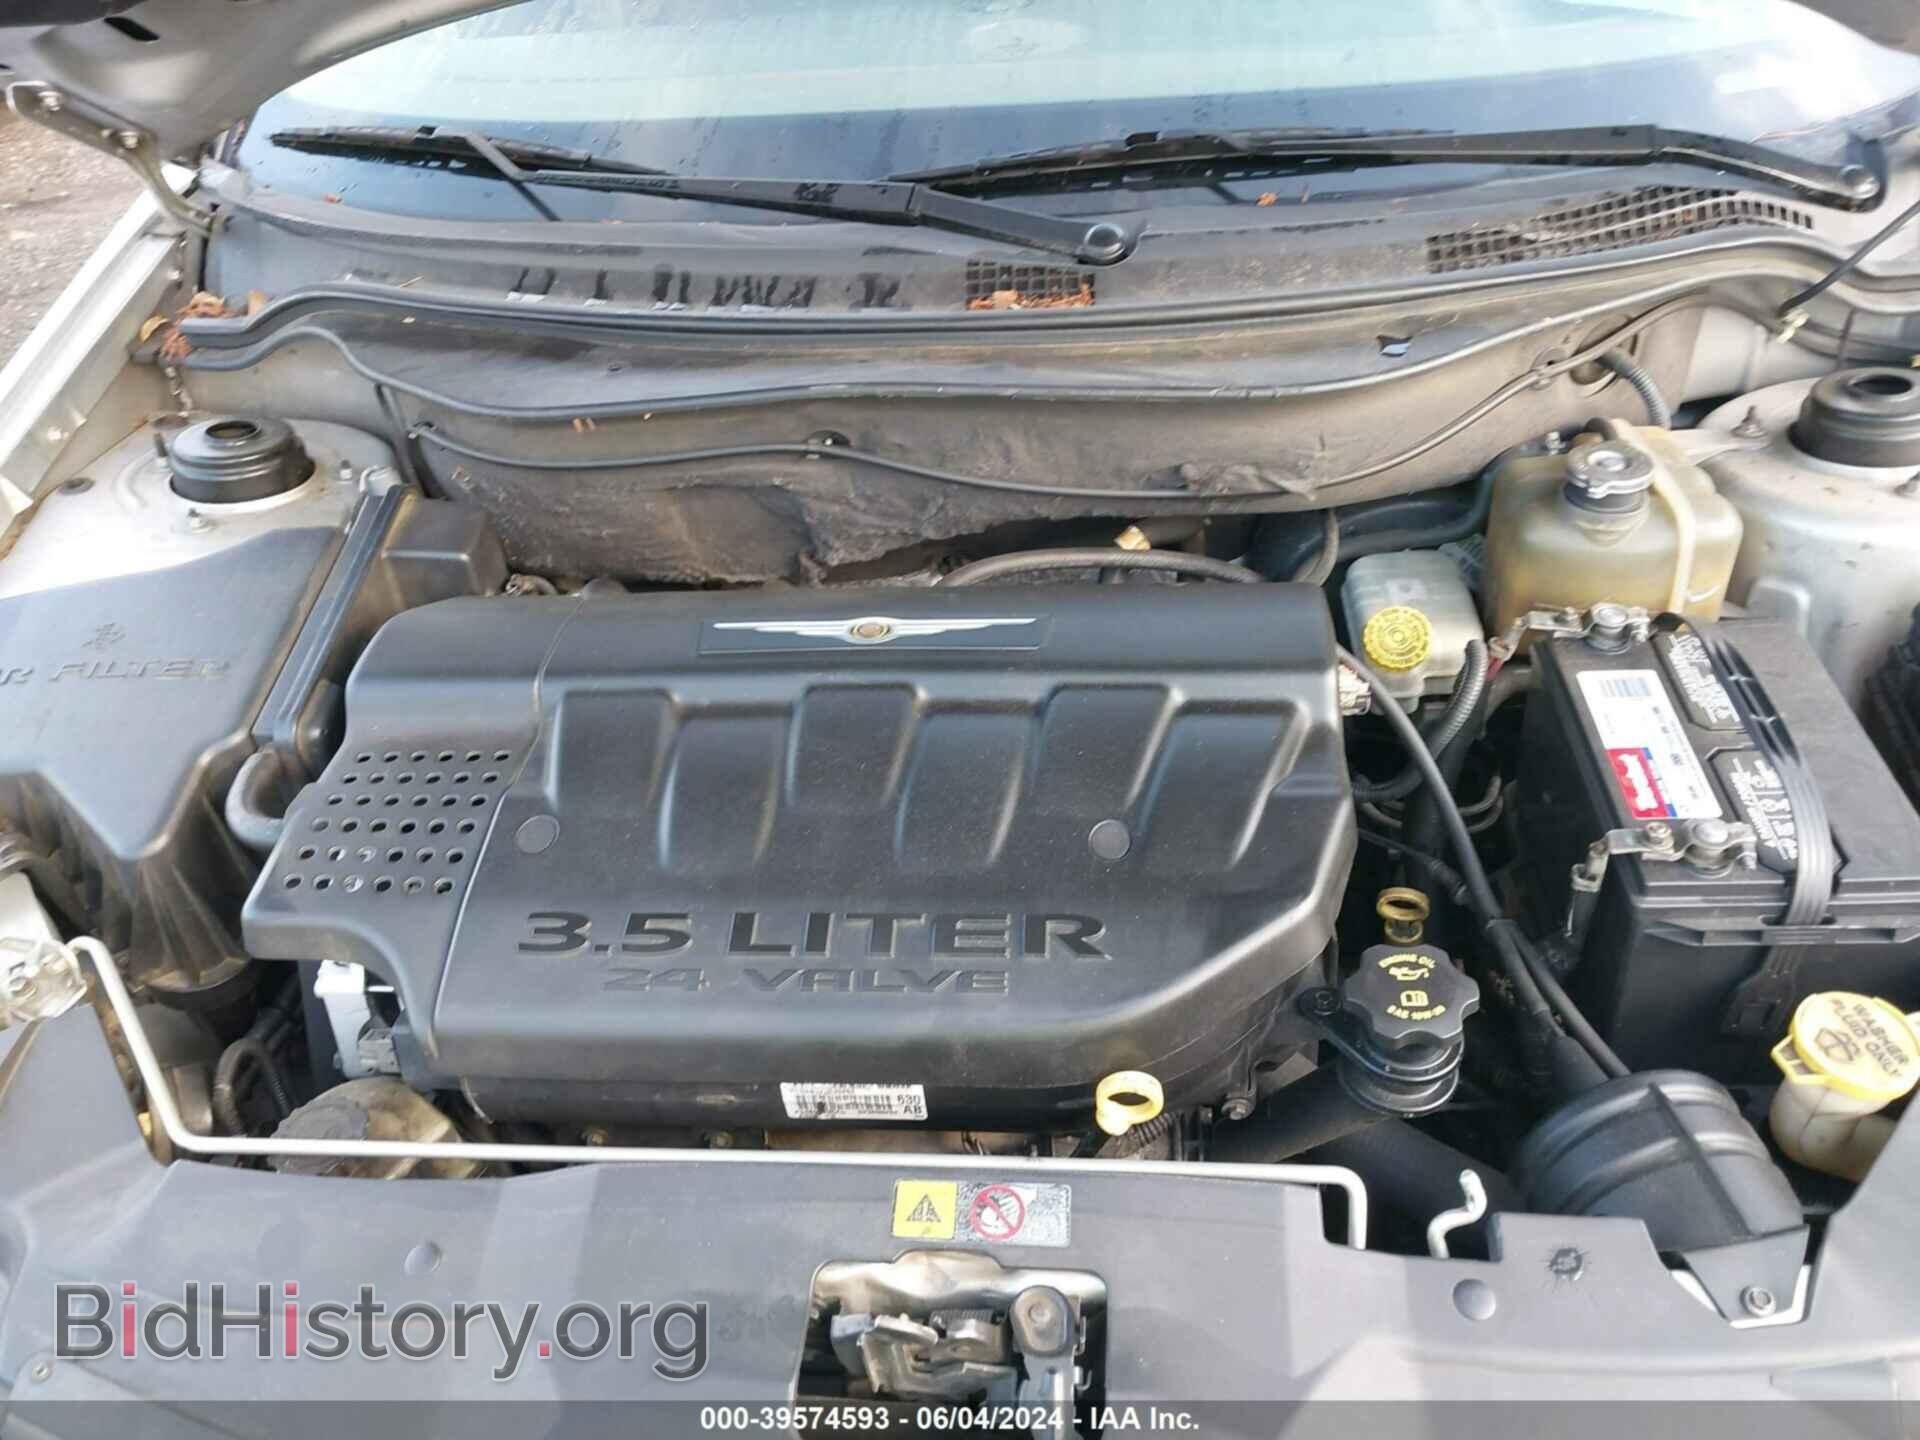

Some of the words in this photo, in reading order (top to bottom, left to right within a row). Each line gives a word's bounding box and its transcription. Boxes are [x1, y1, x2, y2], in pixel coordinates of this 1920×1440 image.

[48, 659, 230, 683] FILTER
[516, 911, 692, 955] 3.5
[726, 911, 1112, 960] LITER
[603, 968, 710, 993] 24
[740, 968, 1010, 995] VALVE
[1830, 998, 1868, 1038] FLUID
[1865, 1041, 1902, 1077] ONLY
[1853, 1003, 1909, 1065] WASHER
